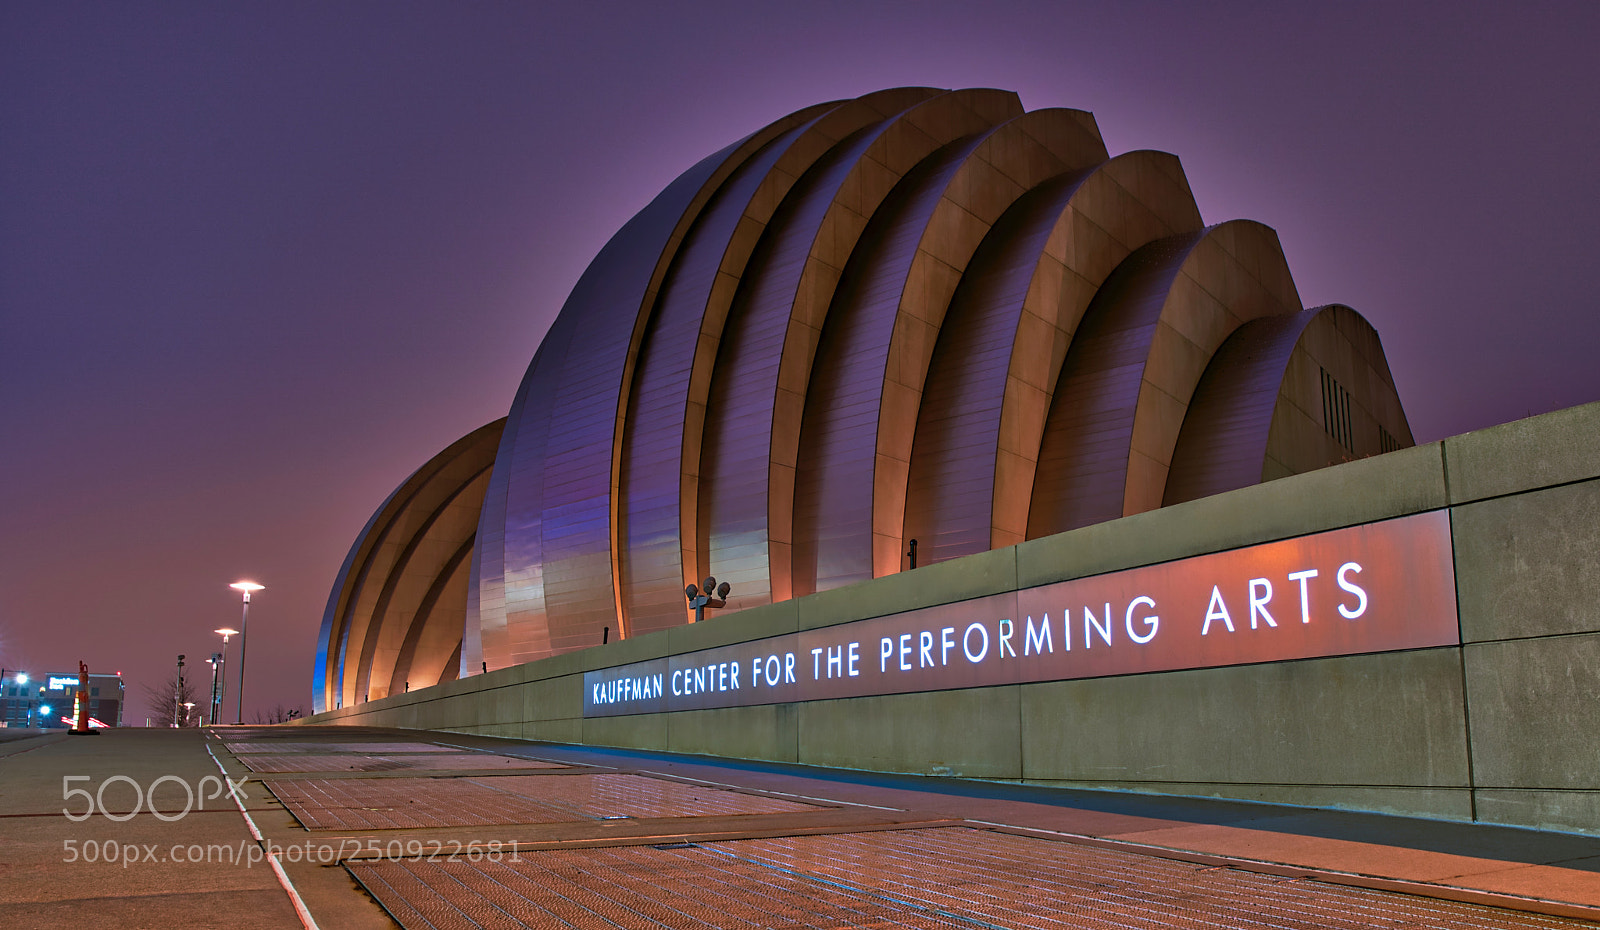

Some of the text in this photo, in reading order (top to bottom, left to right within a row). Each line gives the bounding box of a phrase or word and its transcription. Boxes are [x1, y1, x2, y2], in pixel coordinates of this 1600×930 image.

[593, 561, 1368, 705] KAUFFMAN CENTER FOR THE PERFORMING ARTS
